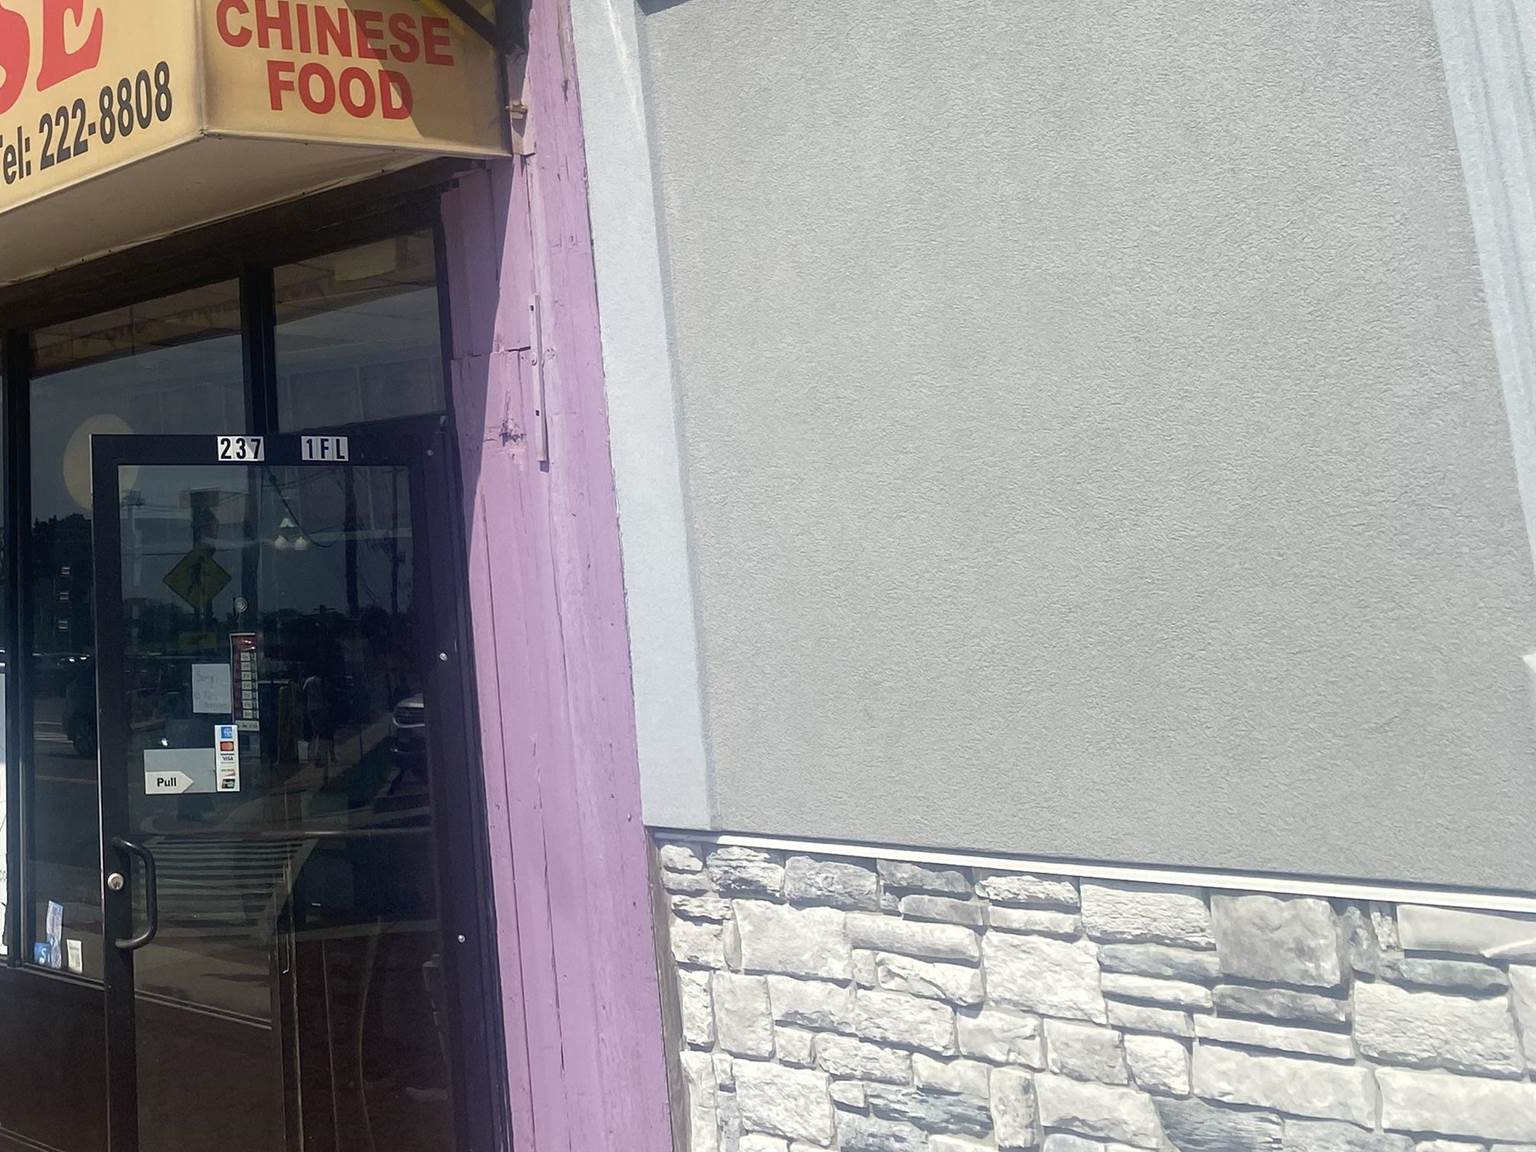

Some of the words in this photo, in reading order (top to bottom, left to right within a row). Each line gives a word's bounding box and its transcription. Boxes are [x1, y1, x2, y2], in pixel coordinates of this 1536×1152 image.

[266, 59, 414, 120] FOOD
[39, 61, 173, 171] 222-8808
[220, 438, 262, 460] 237
[156, 777, 177, 787] Pull
